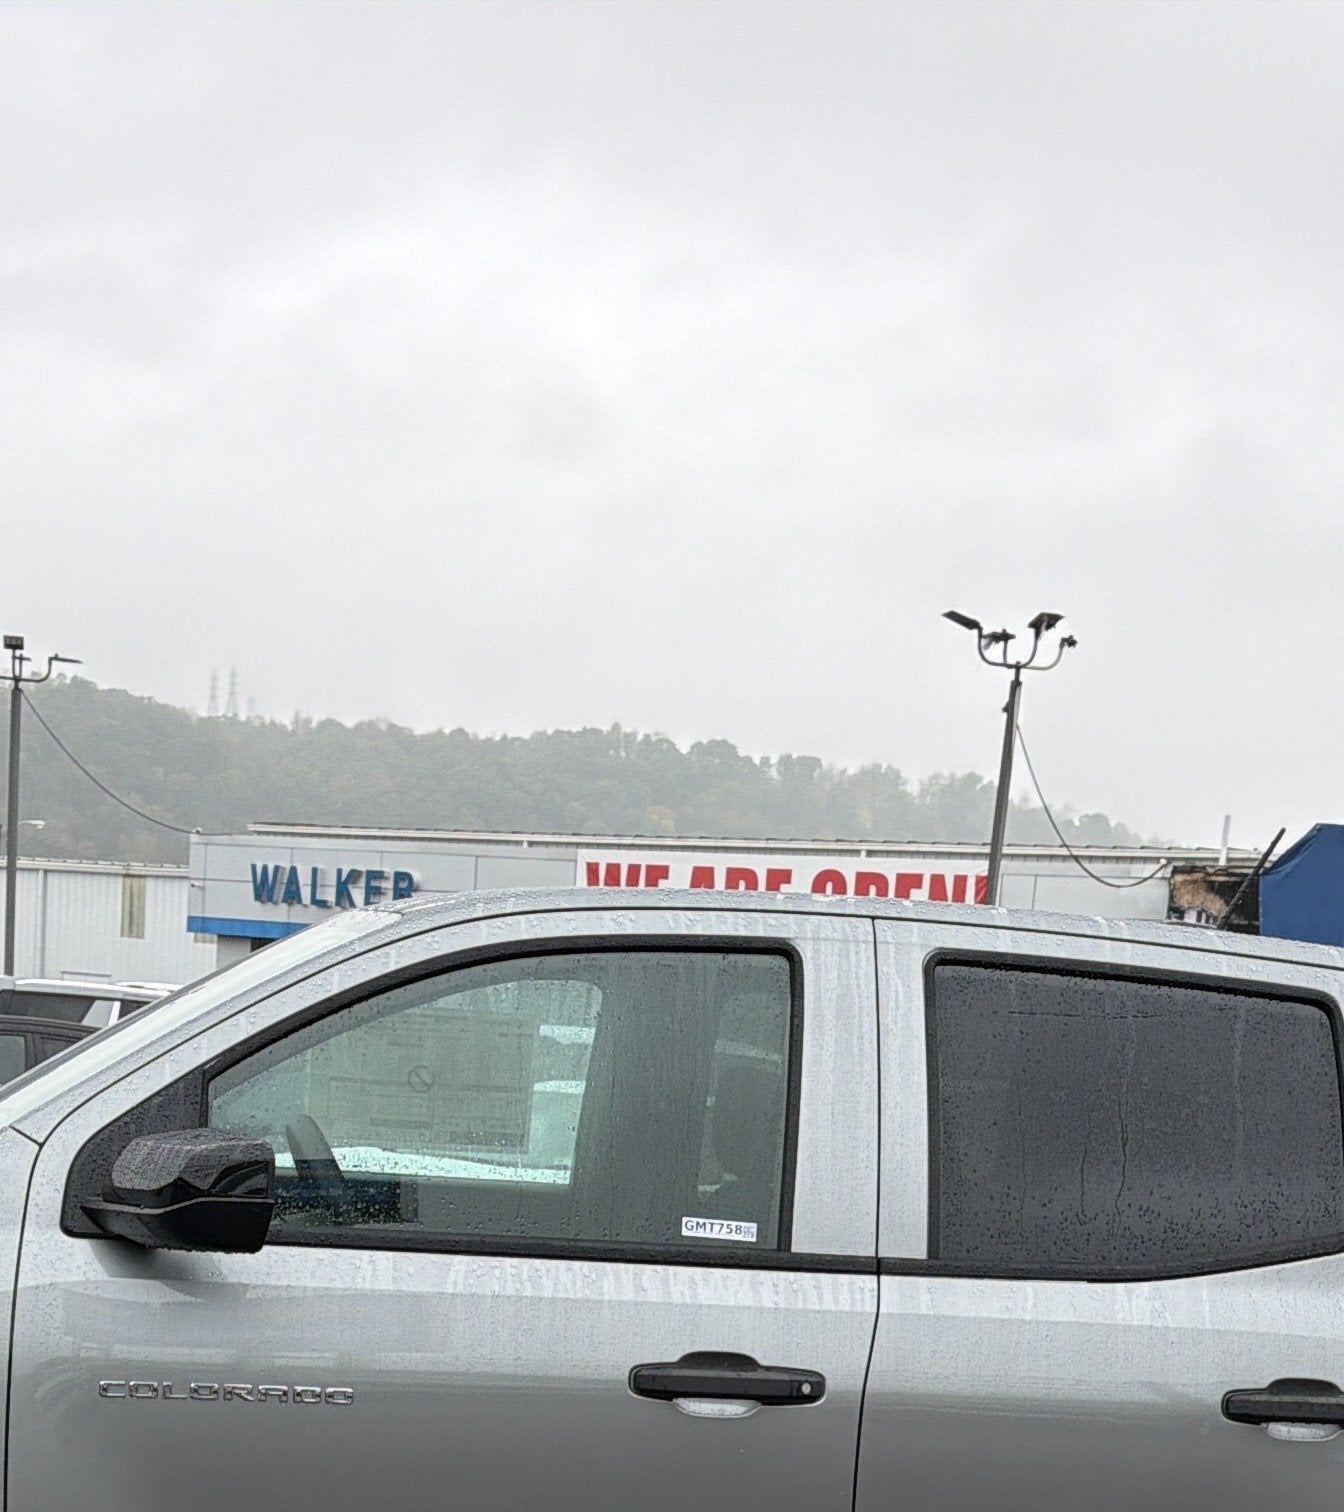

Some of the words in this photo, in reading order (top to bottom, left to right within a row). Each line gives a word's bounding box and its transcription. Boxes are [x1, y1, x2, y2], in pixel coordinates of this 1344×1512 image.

[250, 863, 414, 909] WALKER
[685, 1220, 743, 1235] GMT758
[98, 1380, 354, 1405] COLORADO
